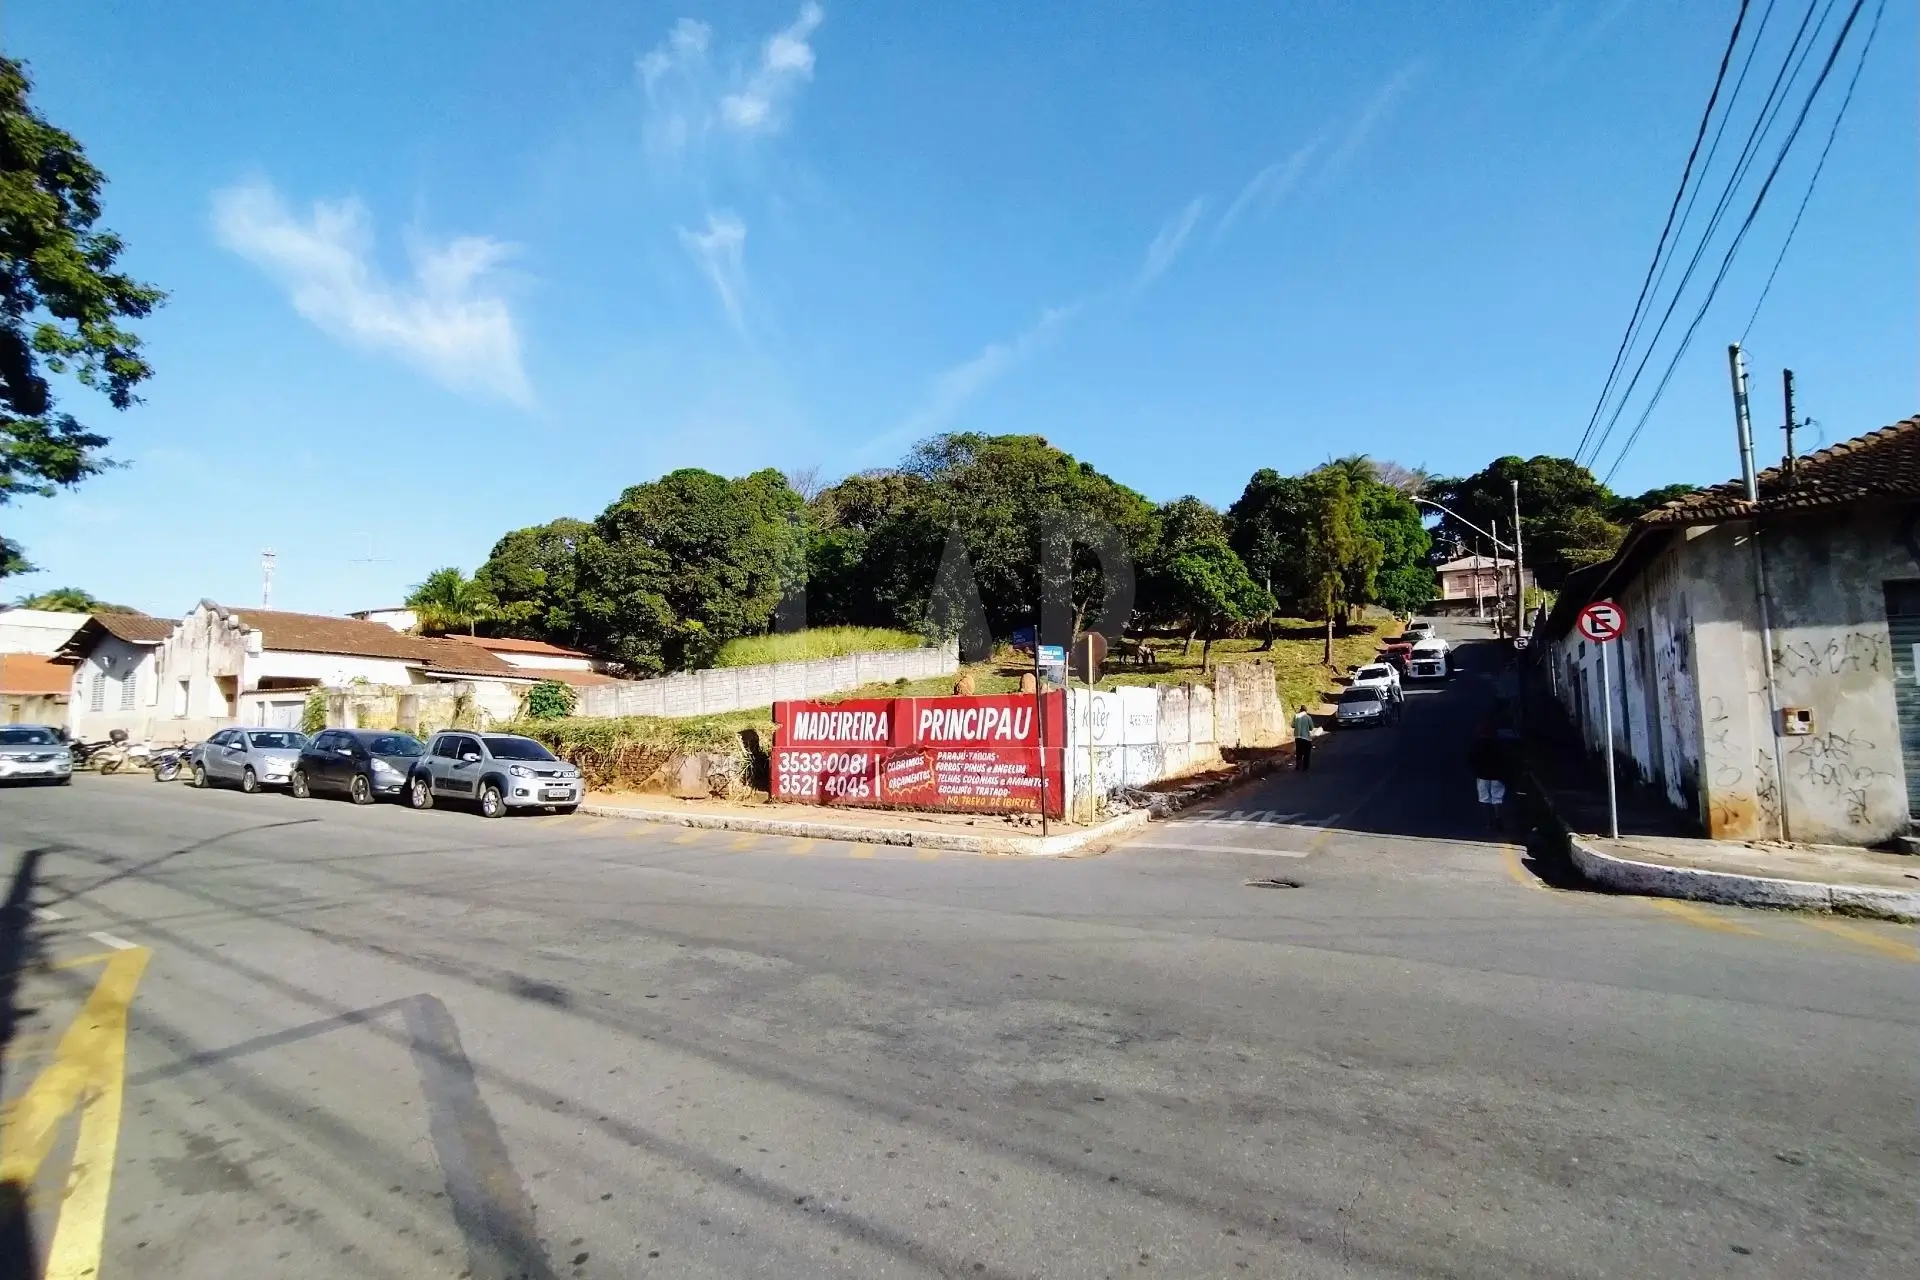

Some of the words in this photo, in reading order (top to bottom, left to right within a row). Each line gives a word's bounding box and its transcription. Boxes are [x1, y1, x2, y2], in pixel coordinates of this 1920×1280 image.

[794, 711, 889, 741] MADEIREIRA
[887, 756, 925, 773] COBRIMOS
[938, 774, 962, 784] TELHAS
